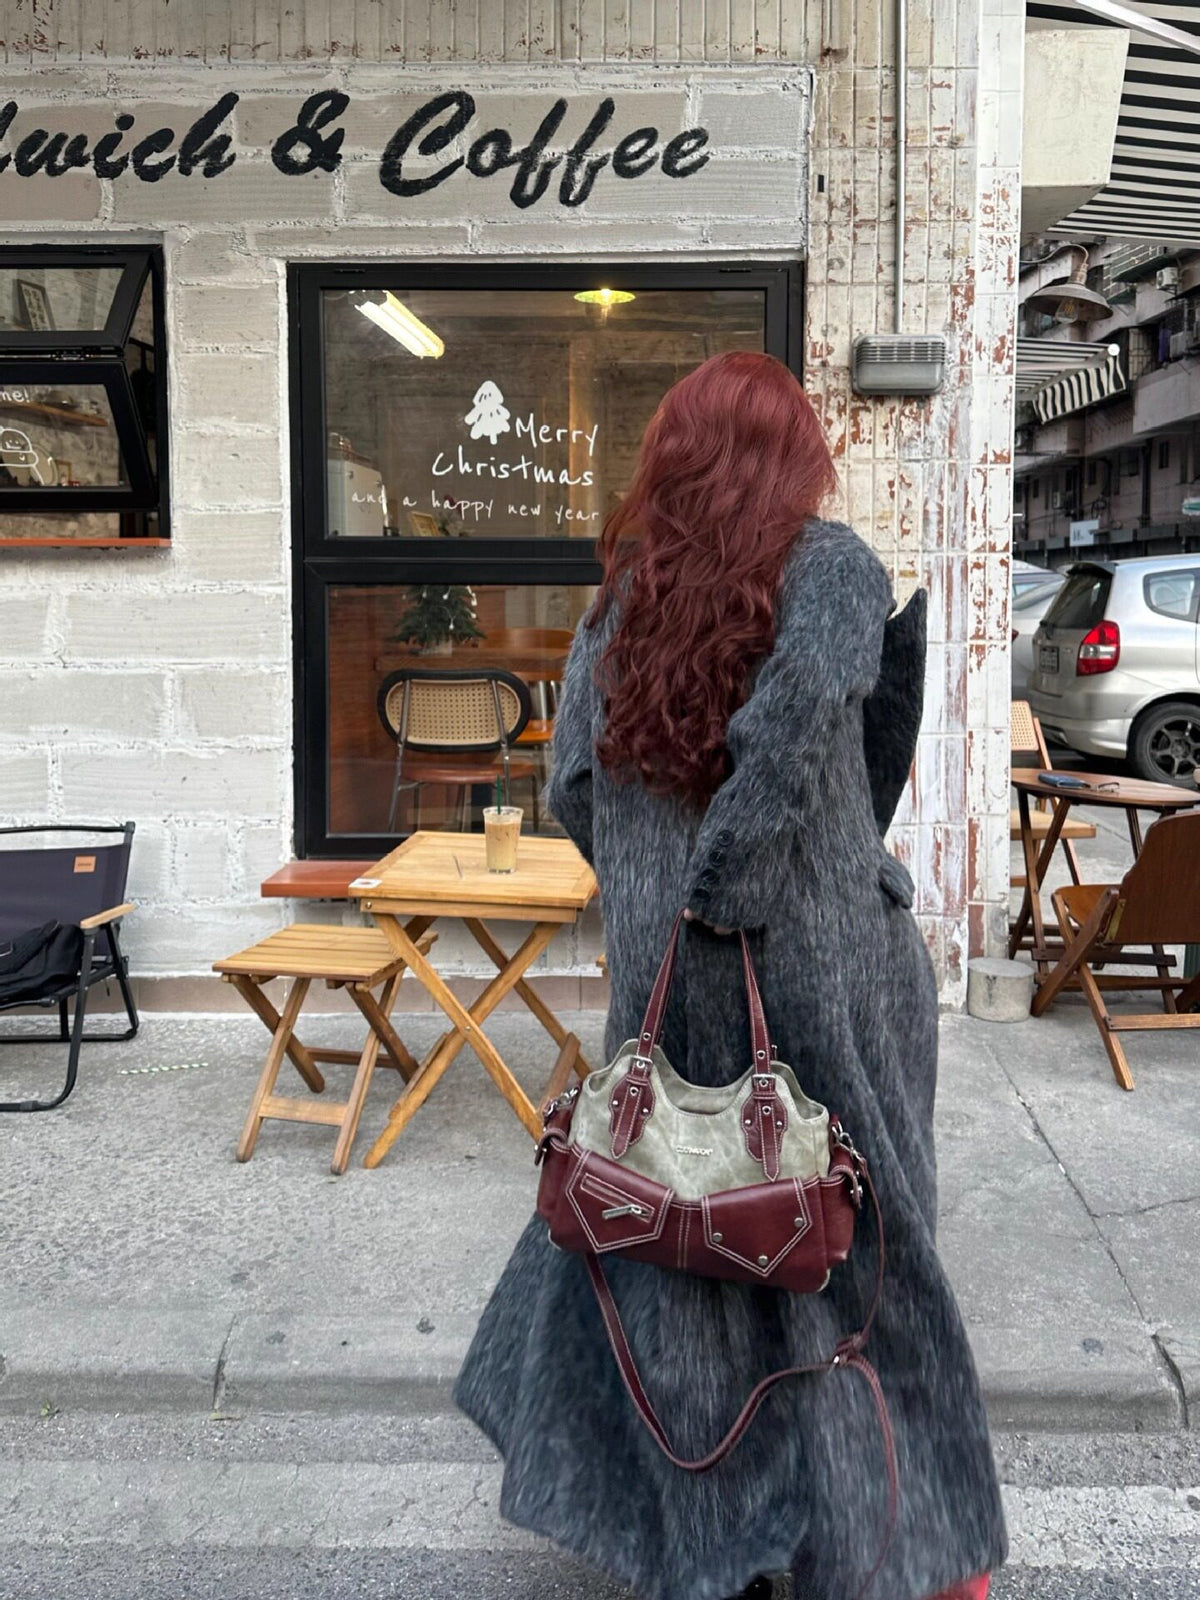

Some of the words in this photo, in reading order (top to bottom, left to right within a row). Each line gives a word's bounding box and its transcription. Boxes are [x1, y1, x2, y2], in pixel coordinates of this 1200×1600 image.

[271, 89, 351, 176] &
[379, 91, 711, 208] Coffee
[515, 413, 599, 457] Merry
[432, 445, 595, 487] Christmas
[351, 485, 388, 505] and
[402, 495, 418, 508] a
[431, 489, 494, 521] happy
[507, 503, 541, 517] new
[554, 504, 600, 525] year
